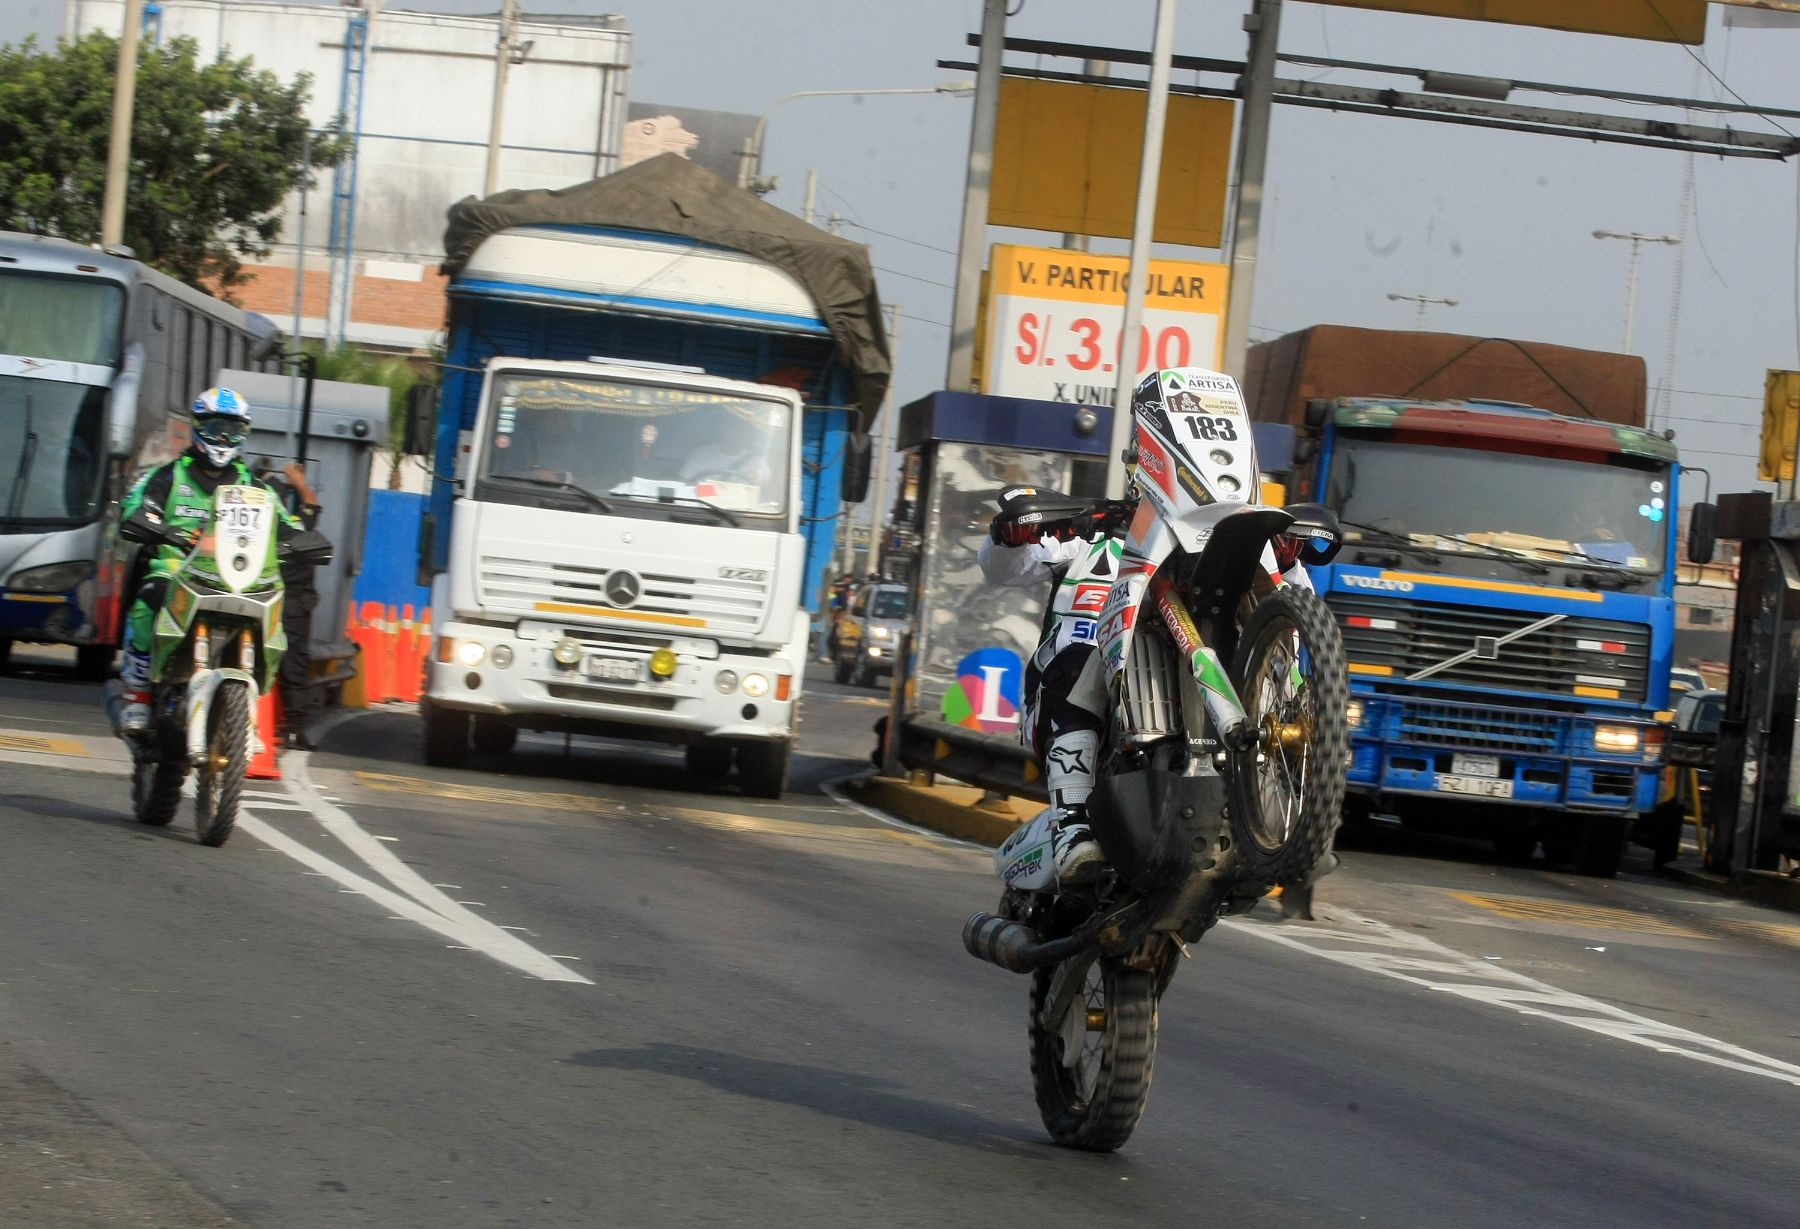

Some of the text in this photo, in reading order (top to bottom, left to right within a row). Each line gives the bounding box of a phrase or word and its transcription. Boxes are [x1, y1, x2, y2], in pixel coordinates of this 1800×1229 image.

[1018, 260, 1037, 284] V.
[1016, 312, 1056, 367] S/.
[1053, 382, 1069, 403] X.
[1188, 379, 1235, 391] ARTISA
[1184, 415, 1238, 442] 183
[1177, 466, 1206, 498] Continental
[230, 508, 261, 527] 167
[1340, 574, 1414, 592] VOLVO
[976, 665, 1020, 724] L
